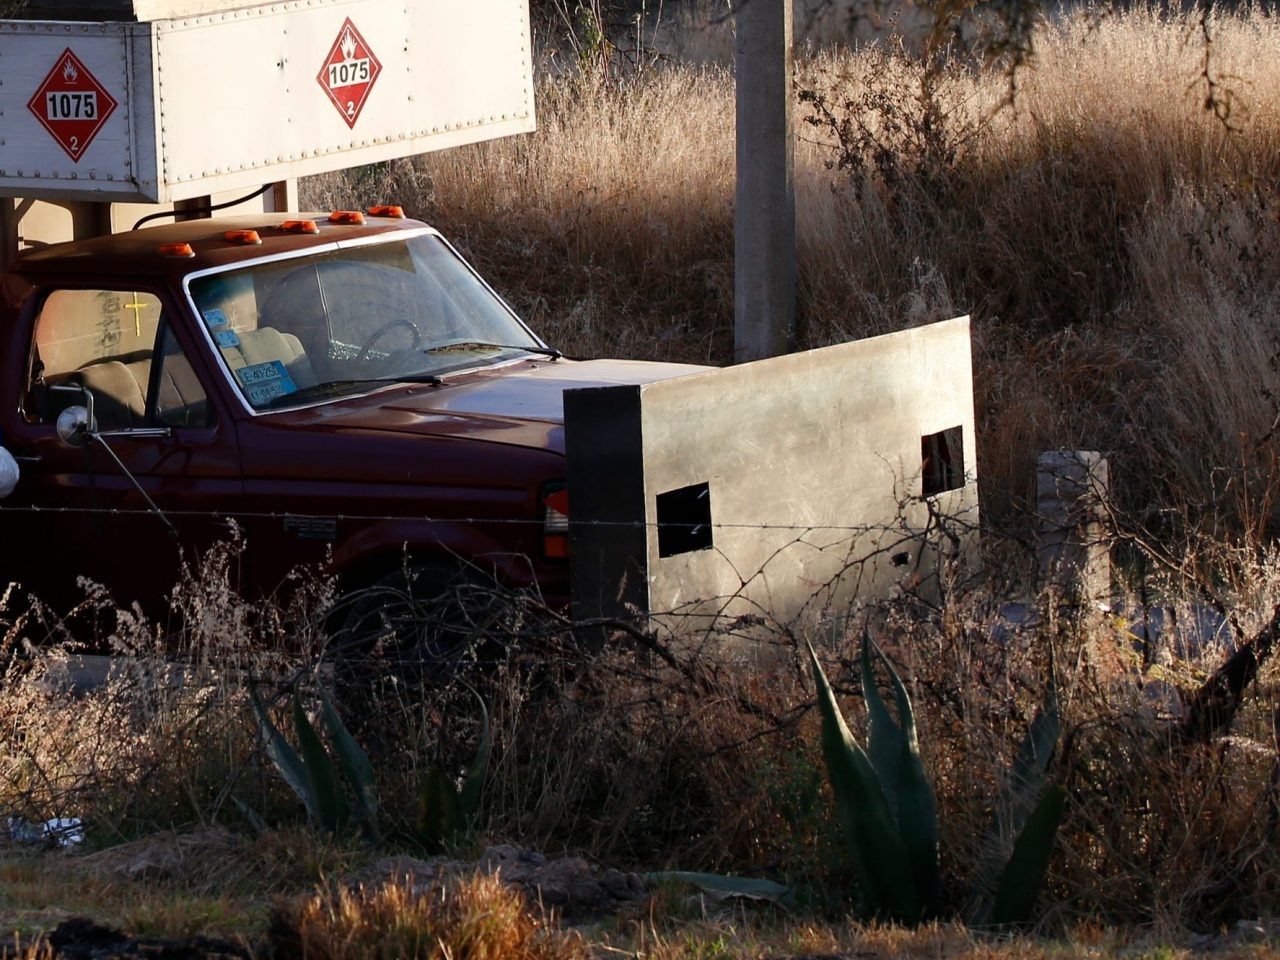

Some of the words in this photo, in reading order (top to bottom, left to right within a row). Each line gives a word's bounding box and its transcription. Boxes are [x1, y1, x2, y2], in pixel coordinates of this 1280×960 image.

[330, 61, 368, 84] 1075
[48, 94, 95, 118] 1075
[347, 101, 355, 115] 2
[70, 136, 79, 151] 2
